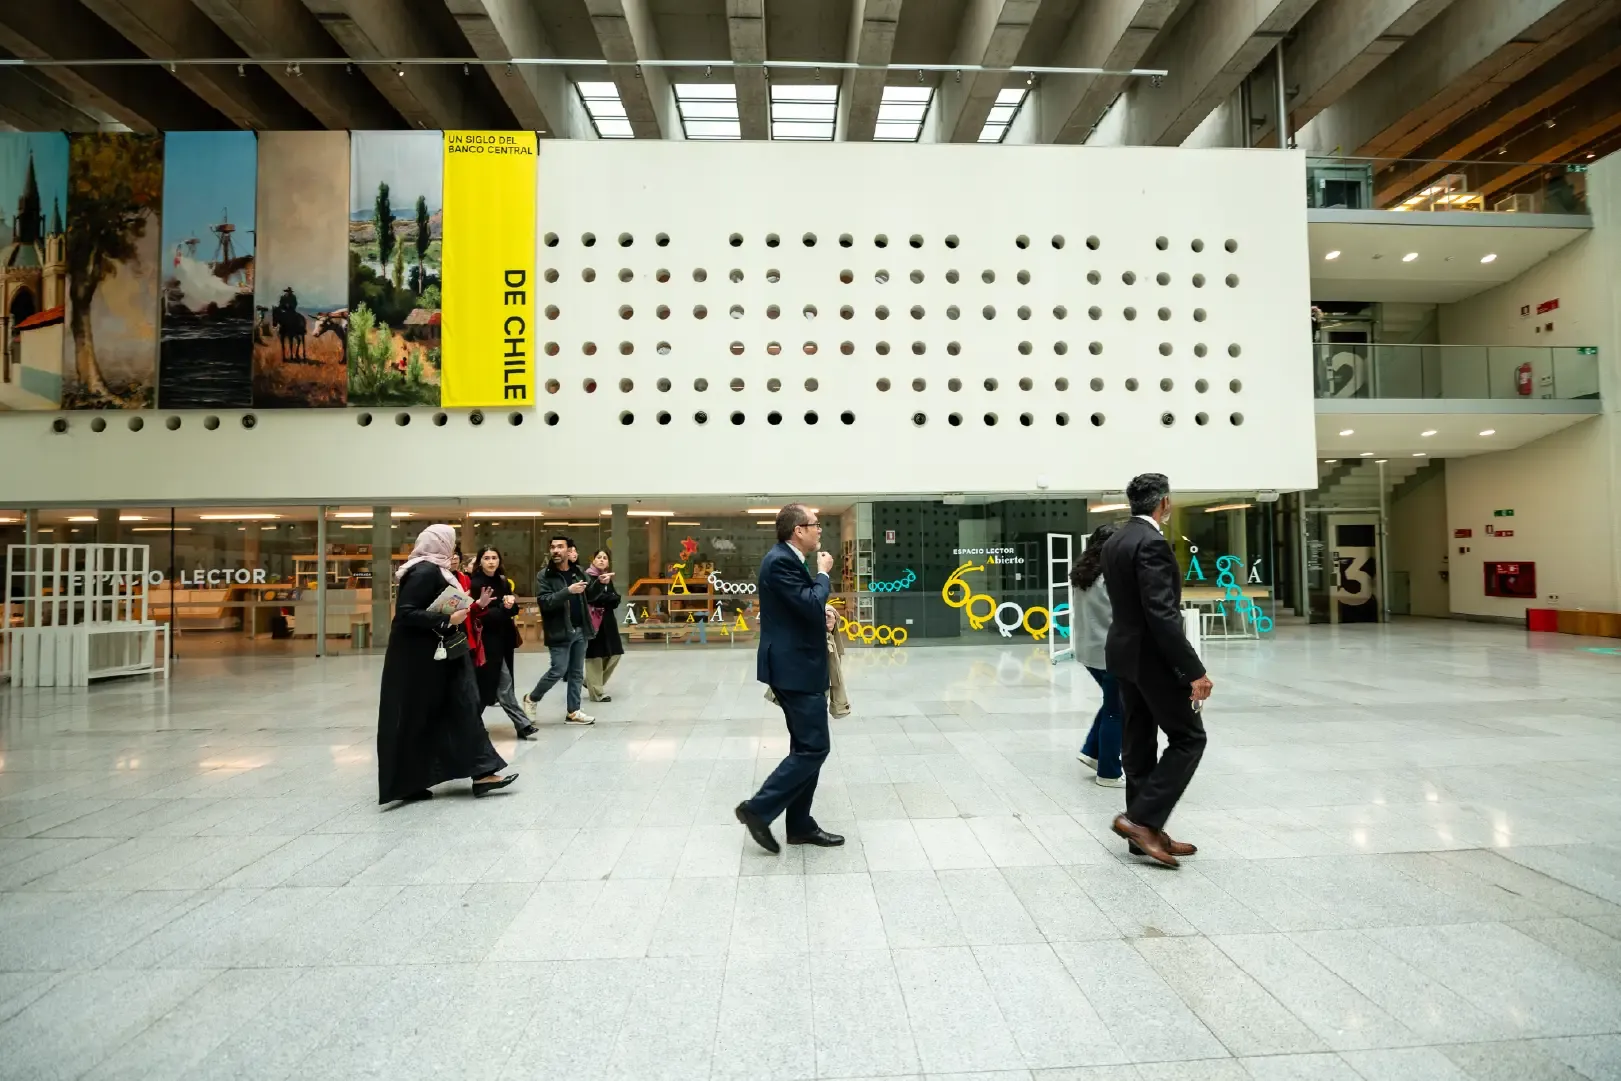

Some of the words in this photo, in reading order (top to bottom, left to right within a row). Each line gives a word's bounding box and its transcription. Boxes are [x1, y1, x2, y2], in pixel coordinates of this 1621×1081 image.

[448, 135, 463, 144] UN
[465, 135, 496, 144] SIGLO
[499, 136, 517, 145] DEL
[448, 145, 484, 153] BANCO
[487, 146, 533, 155] CENTRAL
[503, 269, 526, 306] DE
[503, 316, 527, 400] CHILE
[1331, 351, 1364, 399] 2
[986, 555, 1025, 565] Abierto
[180, 568, 266, 585] LECTOR
[1335, 545, 1373, 606] 3
